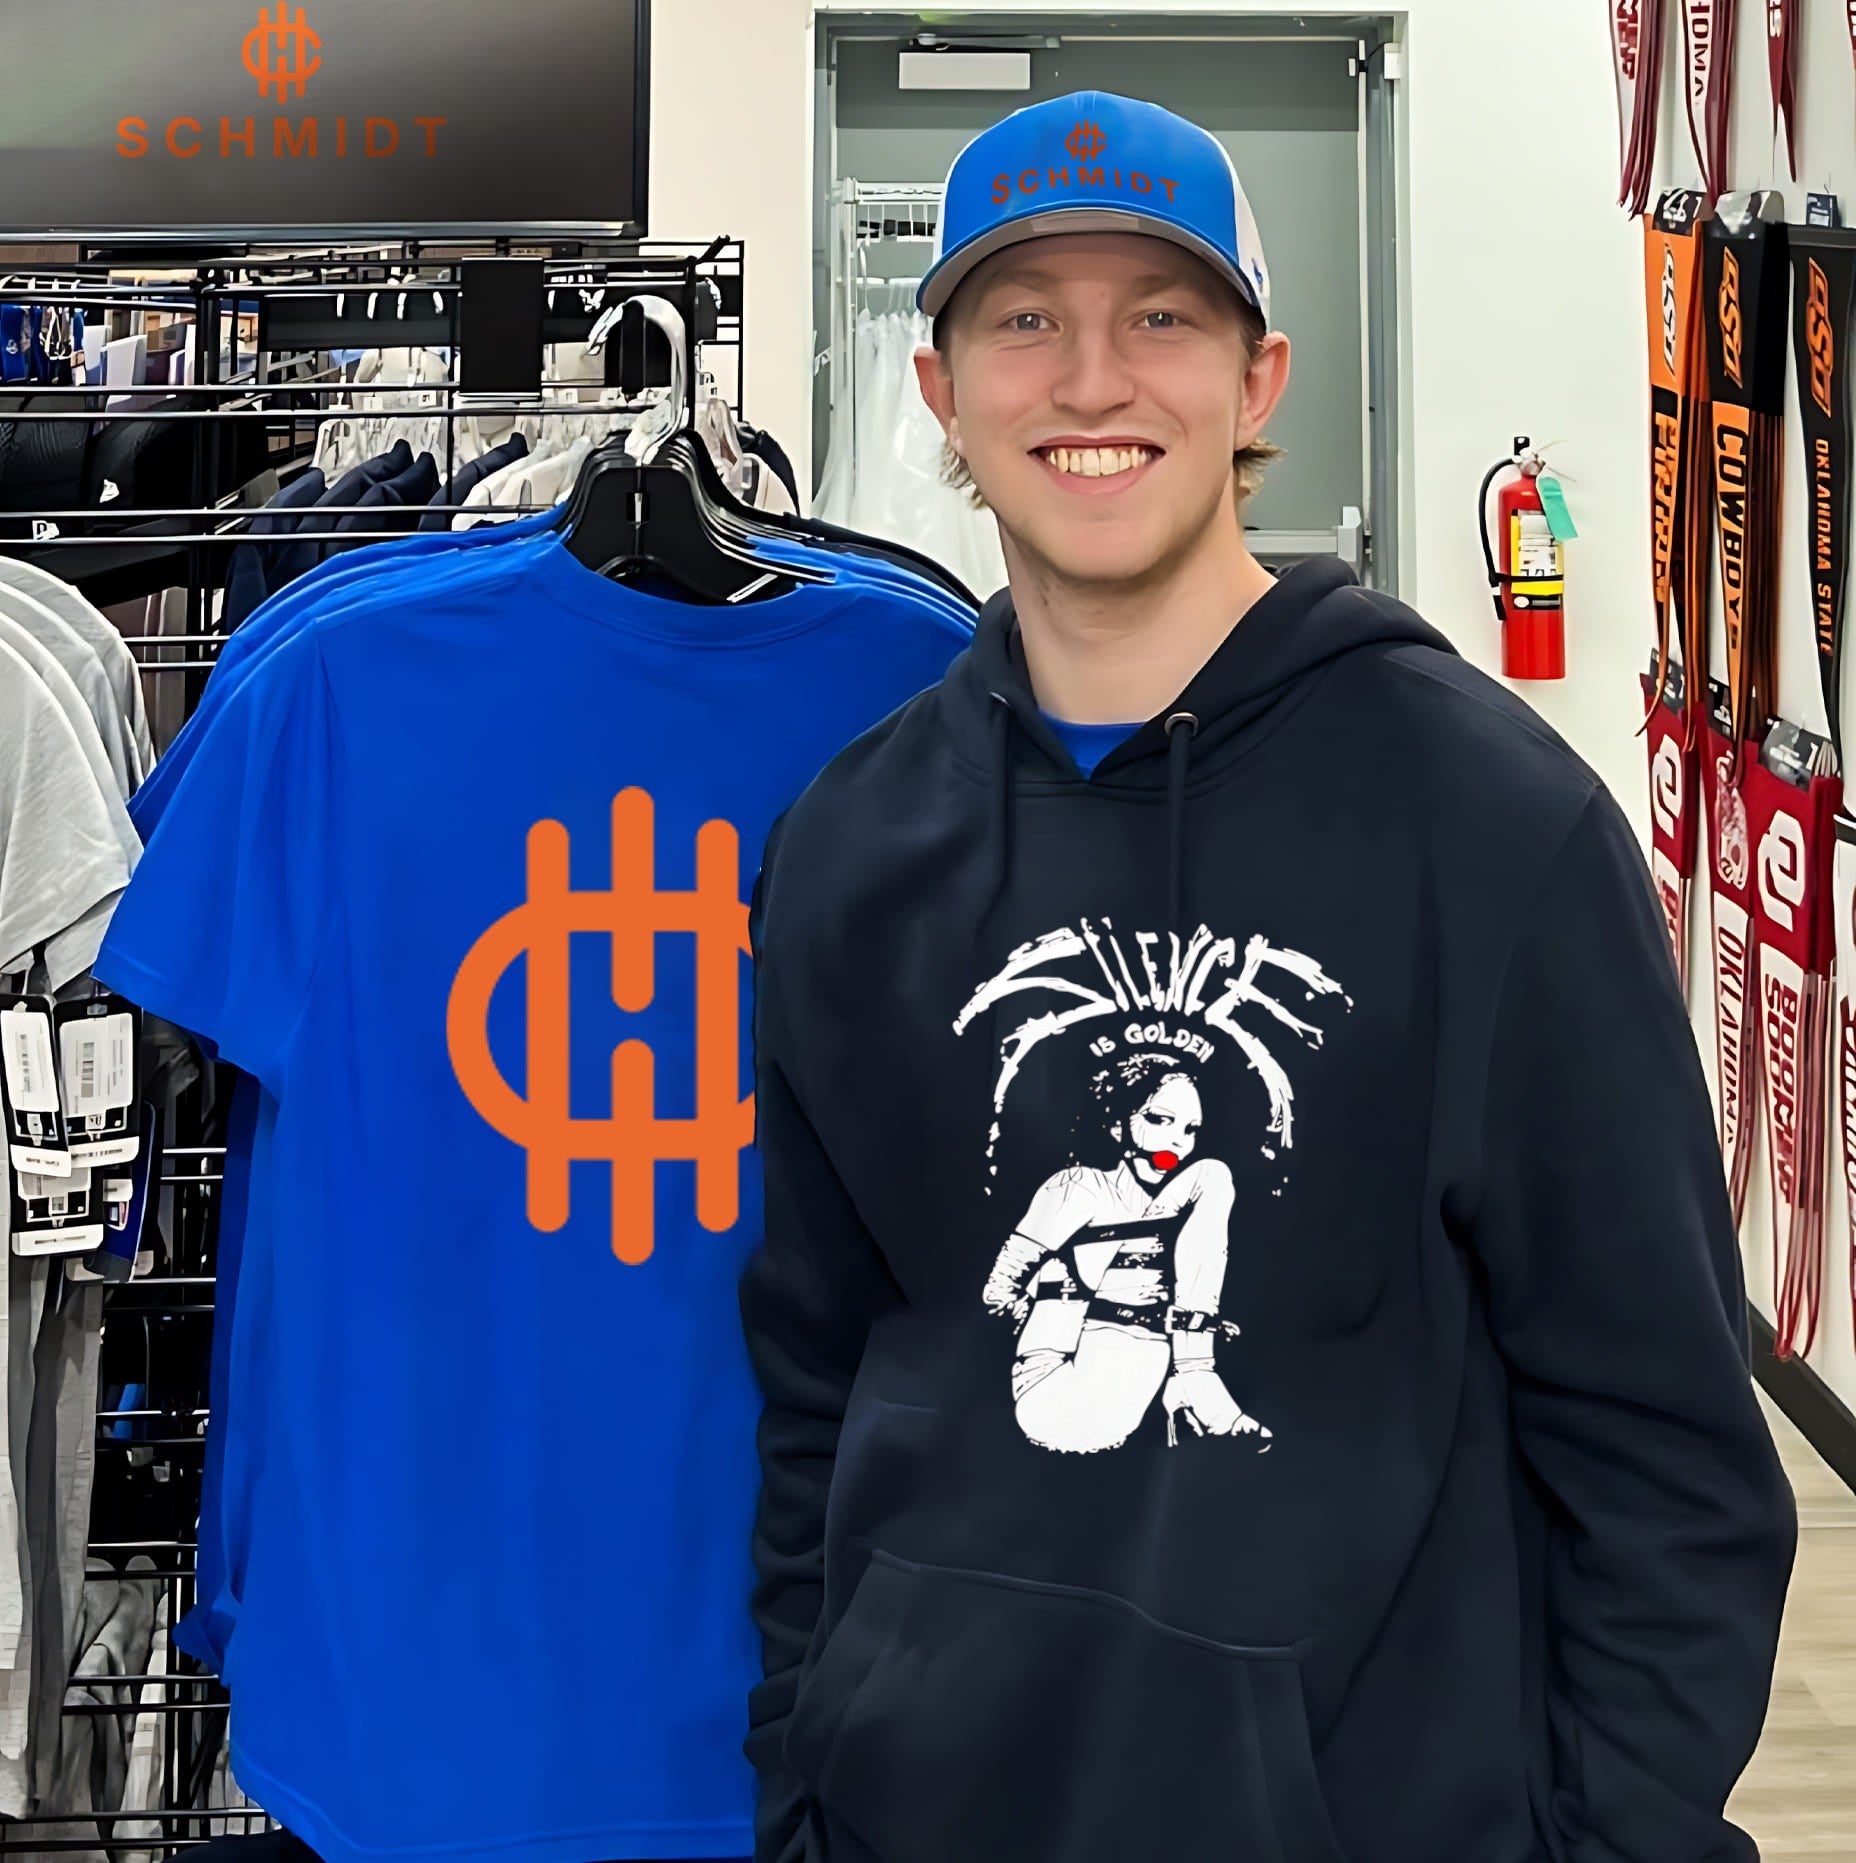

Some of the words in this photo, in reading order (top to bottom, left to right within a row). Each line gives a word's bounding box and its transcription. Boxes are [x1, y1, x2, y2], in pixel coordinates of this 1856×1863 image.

[115, 116, 447, 158] SCHMIDT
[991, 167, 1179, 205] SCHMIDT
[1815, 438, 1833, 570] OKLAHOMA
[953, 917, 1354, 1150] SILENCE
[1089, 1036, 1116, 1058] IS
[1124, 1021, 1216, 1063] GOLDEN
[1717, 926, 1746, 1144] OKLAHOMA
